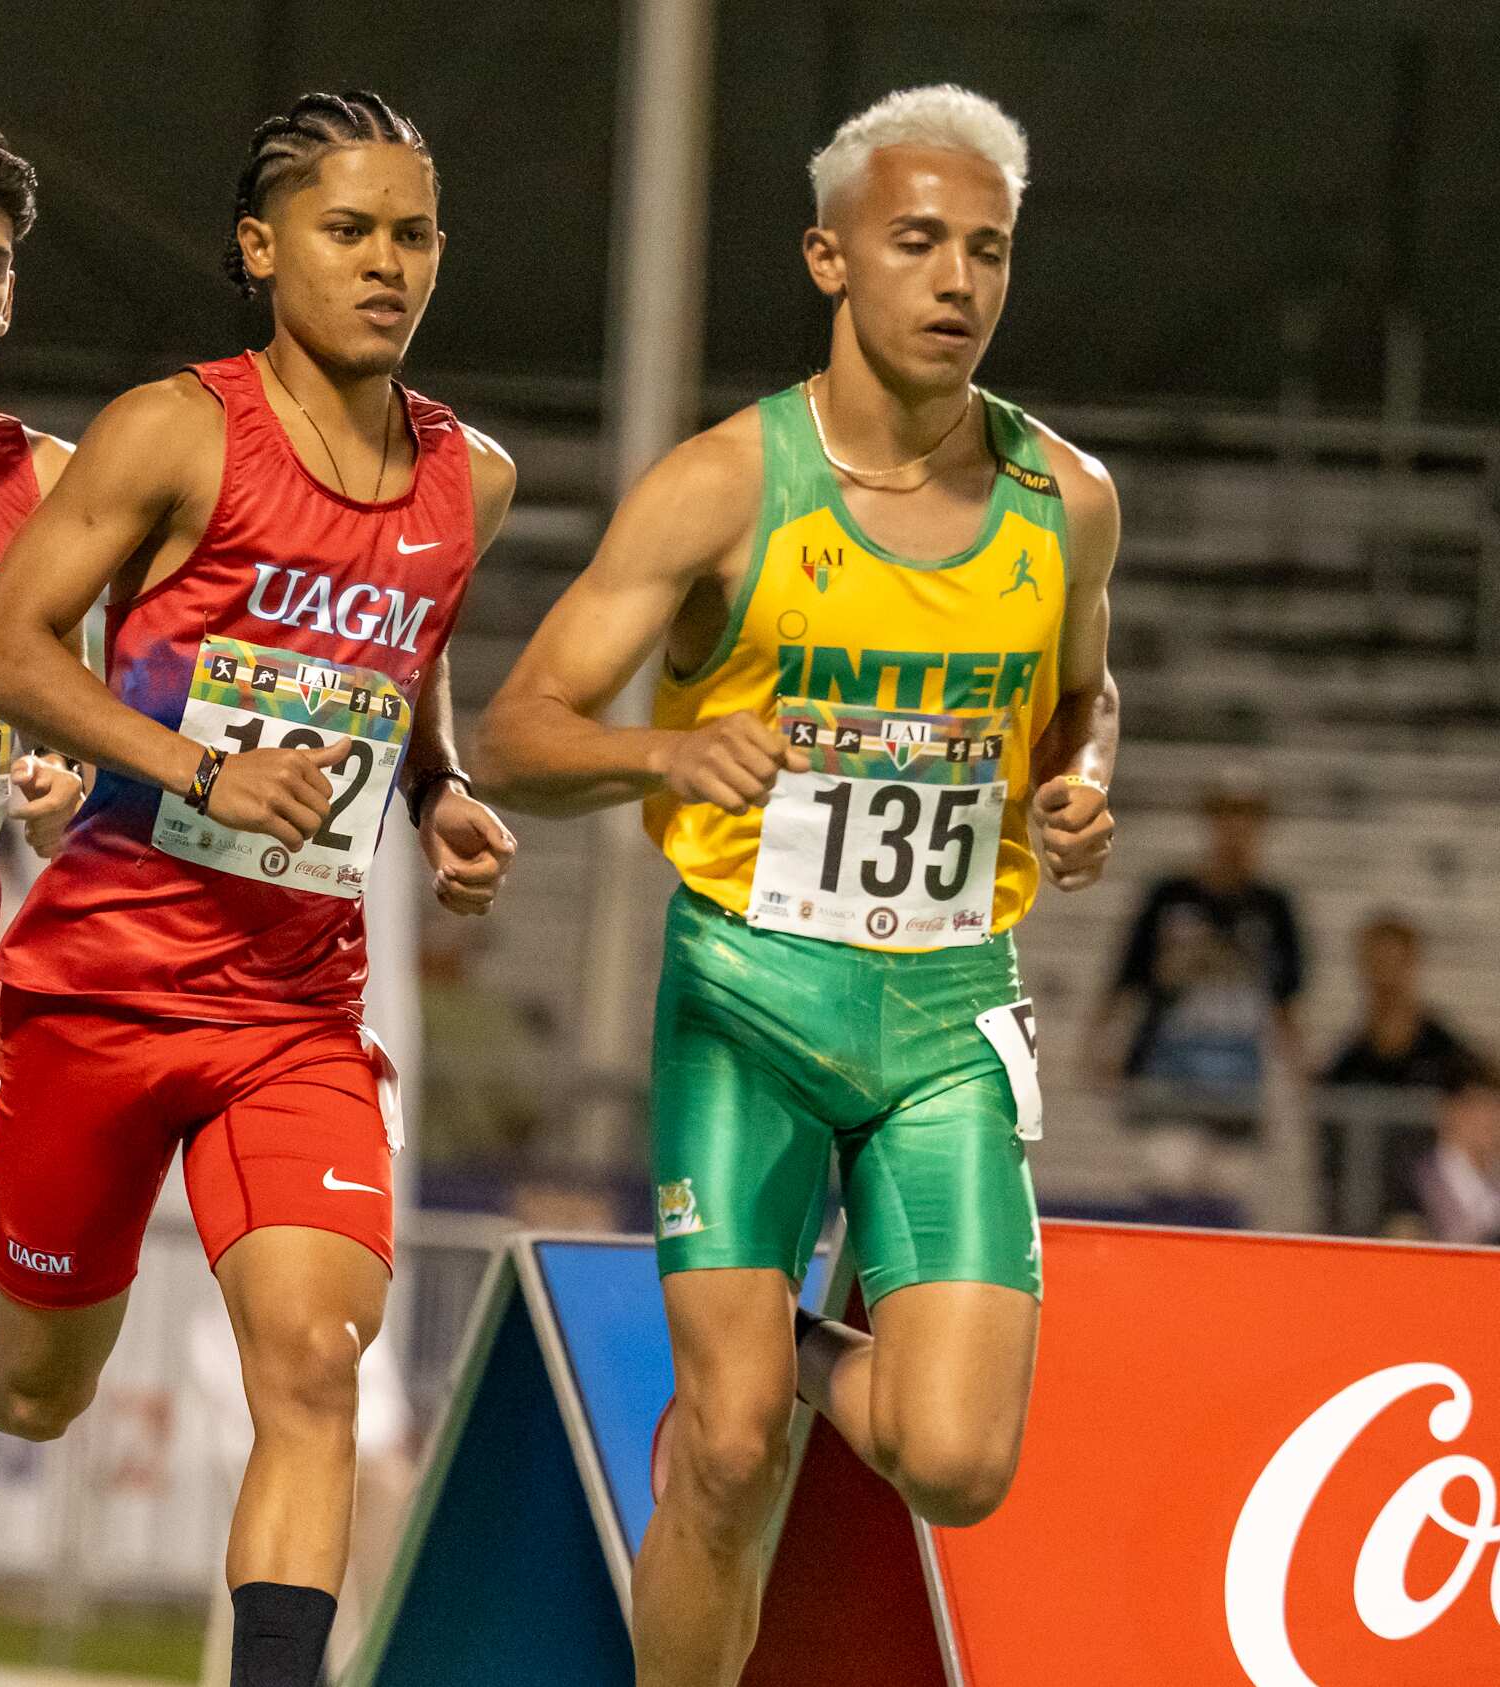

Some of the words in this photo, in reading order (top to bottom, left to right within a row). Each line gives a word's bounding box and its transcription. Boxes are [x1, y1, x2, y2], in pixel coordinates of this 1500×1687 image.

[800, 545, 845, 567] LAI
[246, 561, 437, 655] UAGM
[300, 664, 342, 691] LAI
[774, 644, 1043, 710] INTER
[886, 722, 927, 743] LAI
[813, 781, 981, 901] 135
[7, 1240, 72, 1274] UAGM
[1224, 1361, 1500, 1687] Co
